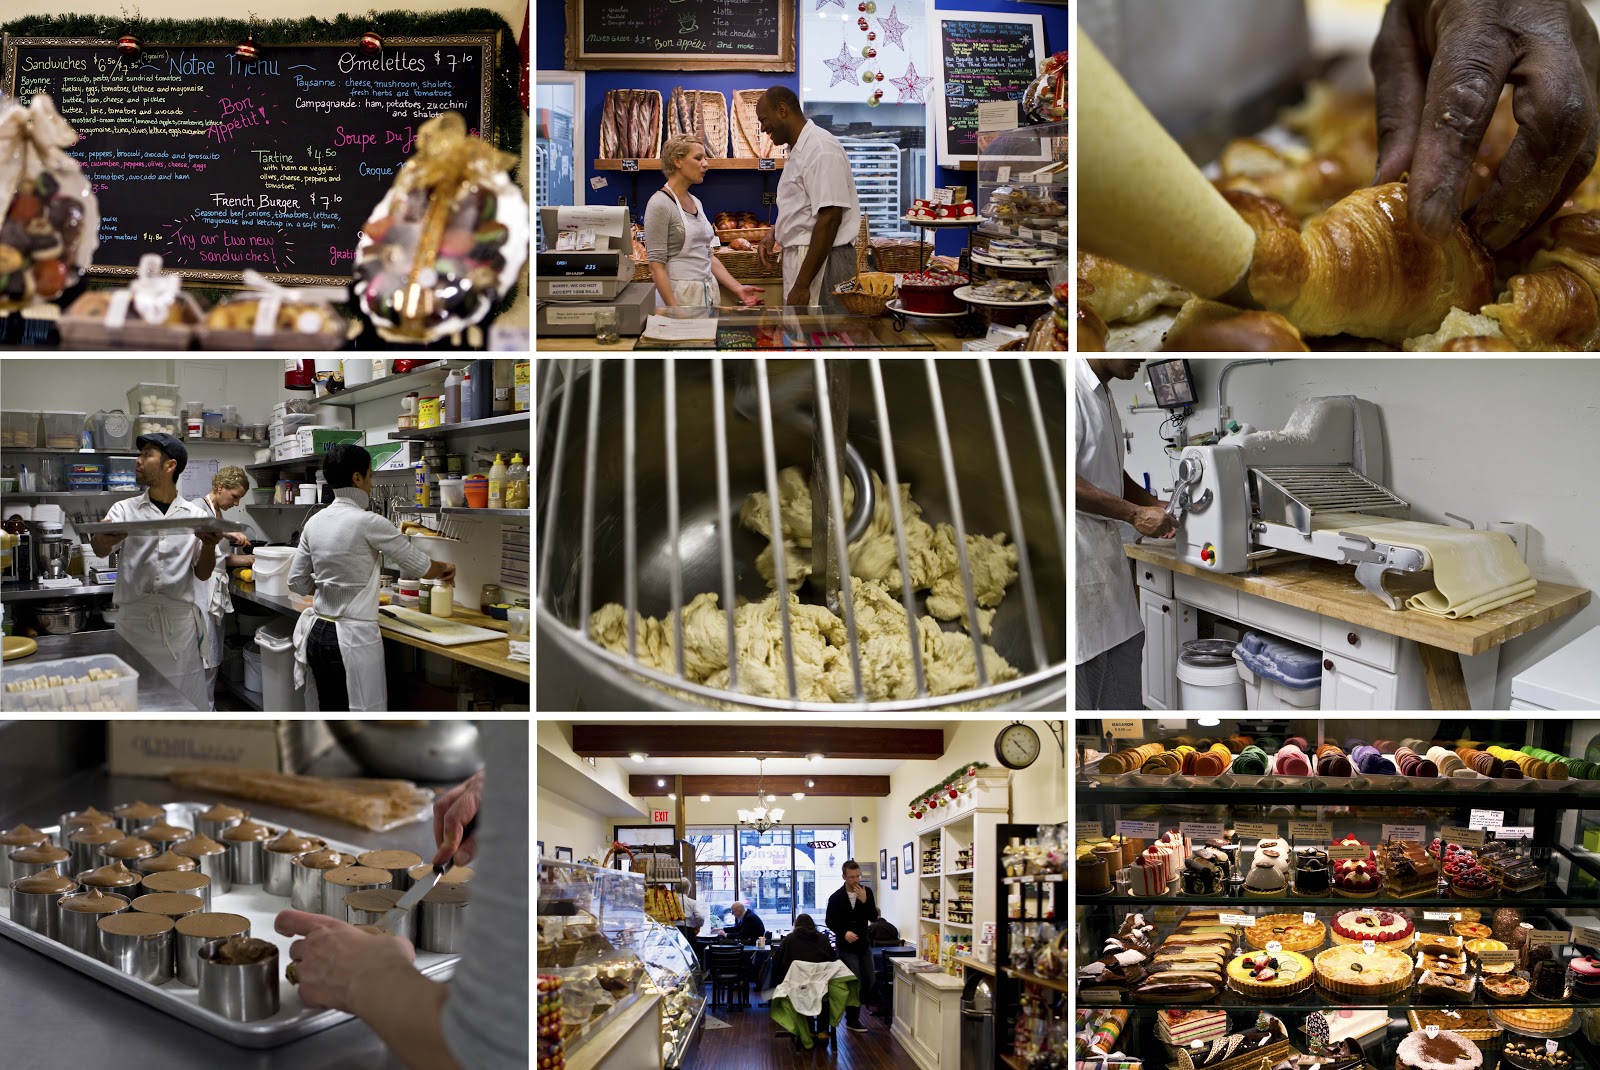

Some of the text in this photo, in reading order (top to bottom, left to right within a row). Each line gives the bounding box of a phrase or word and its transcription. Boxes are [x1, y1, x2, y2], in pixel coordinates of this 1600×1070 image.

[654, 39, 674, 50] Bon
[716, 41, 733, 49] and
[21, 56, 87, 72] Sandwiches
[338, 51, 426, 74] Omelettes
[126, 74, 154, 82] sundried
[345, 77, 373, 89] cheese,
[374, 81, 420, 89] mushroom,
[85, 86, 100, 96] eggs,
[132, 85, 154, 93] lettuce
[350, 88, 452, 97] fresh herbs and tomatoes
[103, 96, 124, 104] cheese
[142, 96, 166, 106] pickles
[365, 99, 384, 109] ham,
[386, 100, 425, 112] potatoes,
[427, 100, 468, 110] zucchini
[154, 107, 184, 115] avocado
[219, 97, 254, 118] Bon
[392, 110, 408, 118] and
[334, 126, 420, 154] Soupe Du Jo
[88, 151, 116, 162] peppers,
[144, 150, 170, 158] avocado
[251, 150, 294, 163] Tartine
[123, 161, 148, 170] peppers,
[192, 163, 207, 172] eggs
[359, 162, 394, 182] Croque
[94, 172, 128, 182] tomatoes,
[174, 172, 190, 180] ham
[279, 174, 303, 182] cheese,
[304, 176, 328, 185] peppers
[328, 174, 341, 182] and
[210, 192, 255, 208] French
[256, 195, 300, 214] Burger
[194, 208, 228, 218] Seasoned
[274, 212, 312, 220] tomatoes,
[313, 212, 342, 222] lettuce,
[202, 218, 239, 228] mayonaise
[257, 219, 283, 229] ketchup
[302, 221, 318, 230] soft
[171, 227, 274, 250] Try our two new
[200, 248, 276, 264] sandwiches!
[654, 811, 669, 822] EXIT
